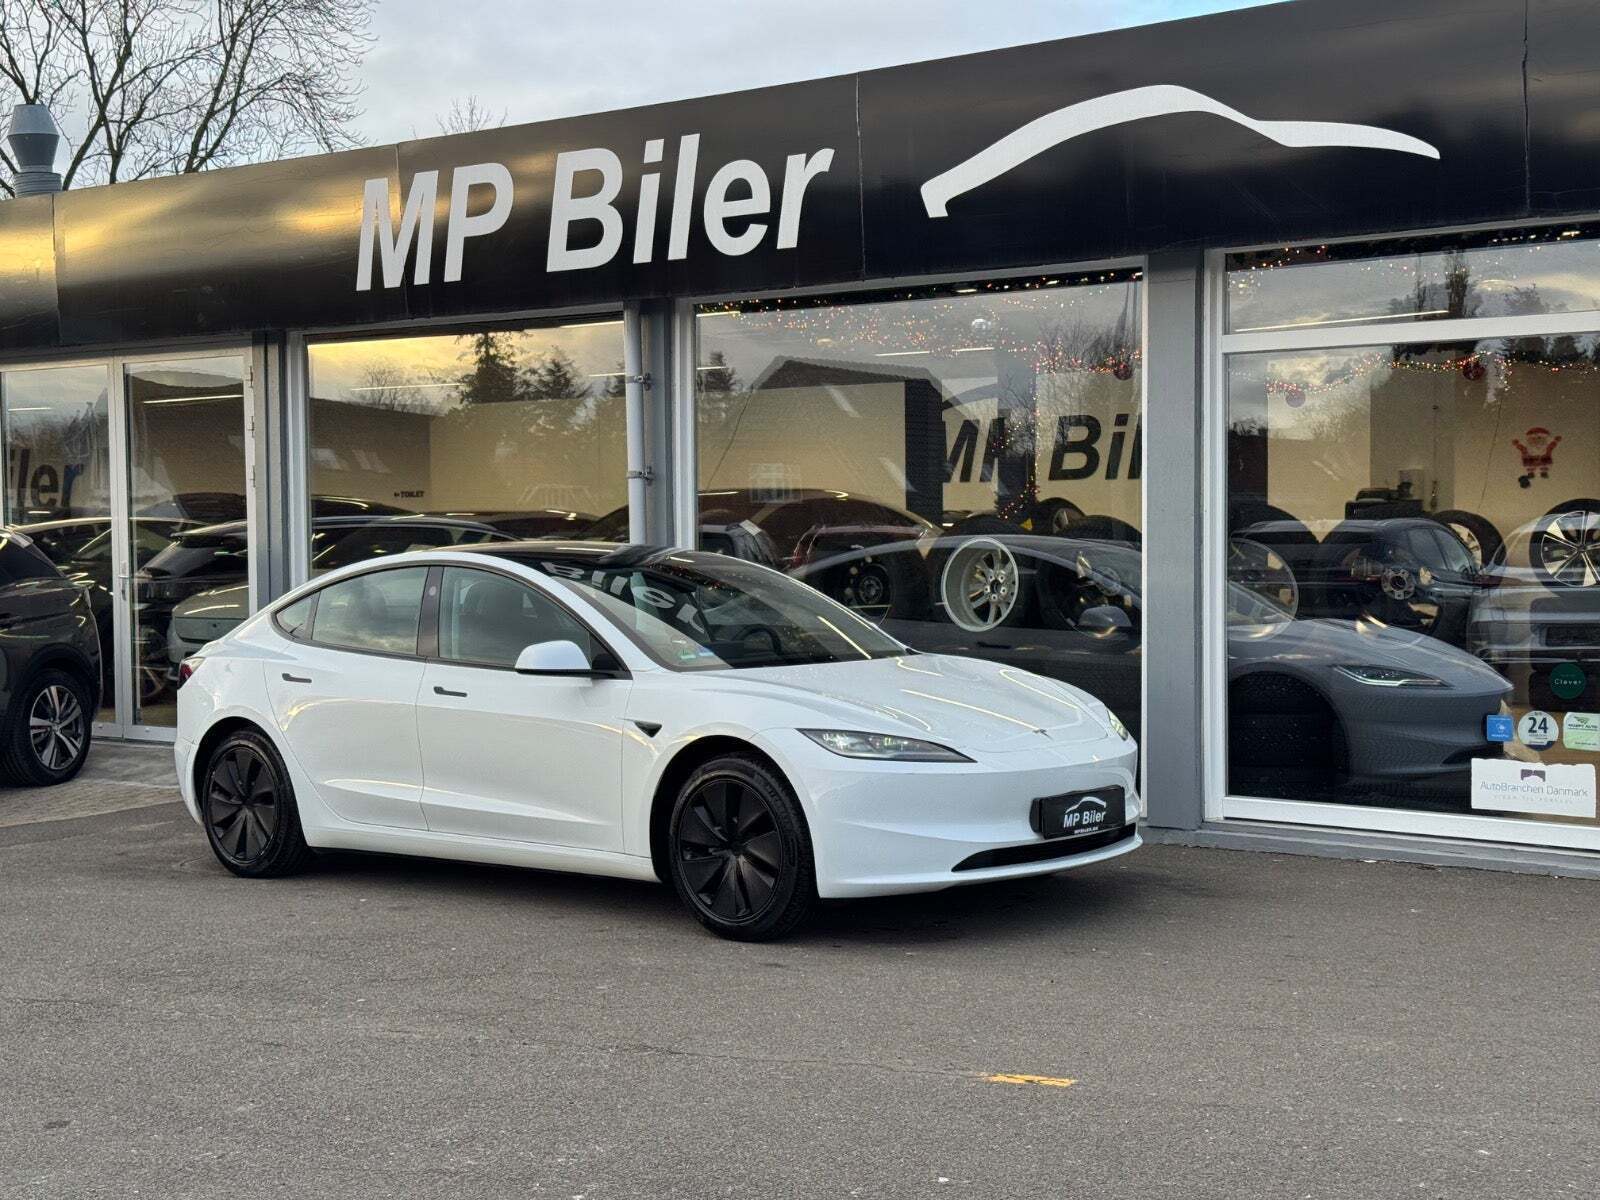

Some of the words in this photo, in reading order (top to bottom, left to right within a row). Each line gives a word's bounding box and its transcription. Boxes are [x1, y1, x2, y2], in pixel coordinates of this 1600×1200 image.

[355, 162, 514, 292] MP
[546, 133, 836, 273] Biler
[1528, 717, 1549, 734] 24
[1480, 782, 1544, 794] AutoBranchen
[1546, 785, 1588, 797] Danmark
[1063, 814, 1080, 828] MP
[1082, 811, 1106, 825] Biler
